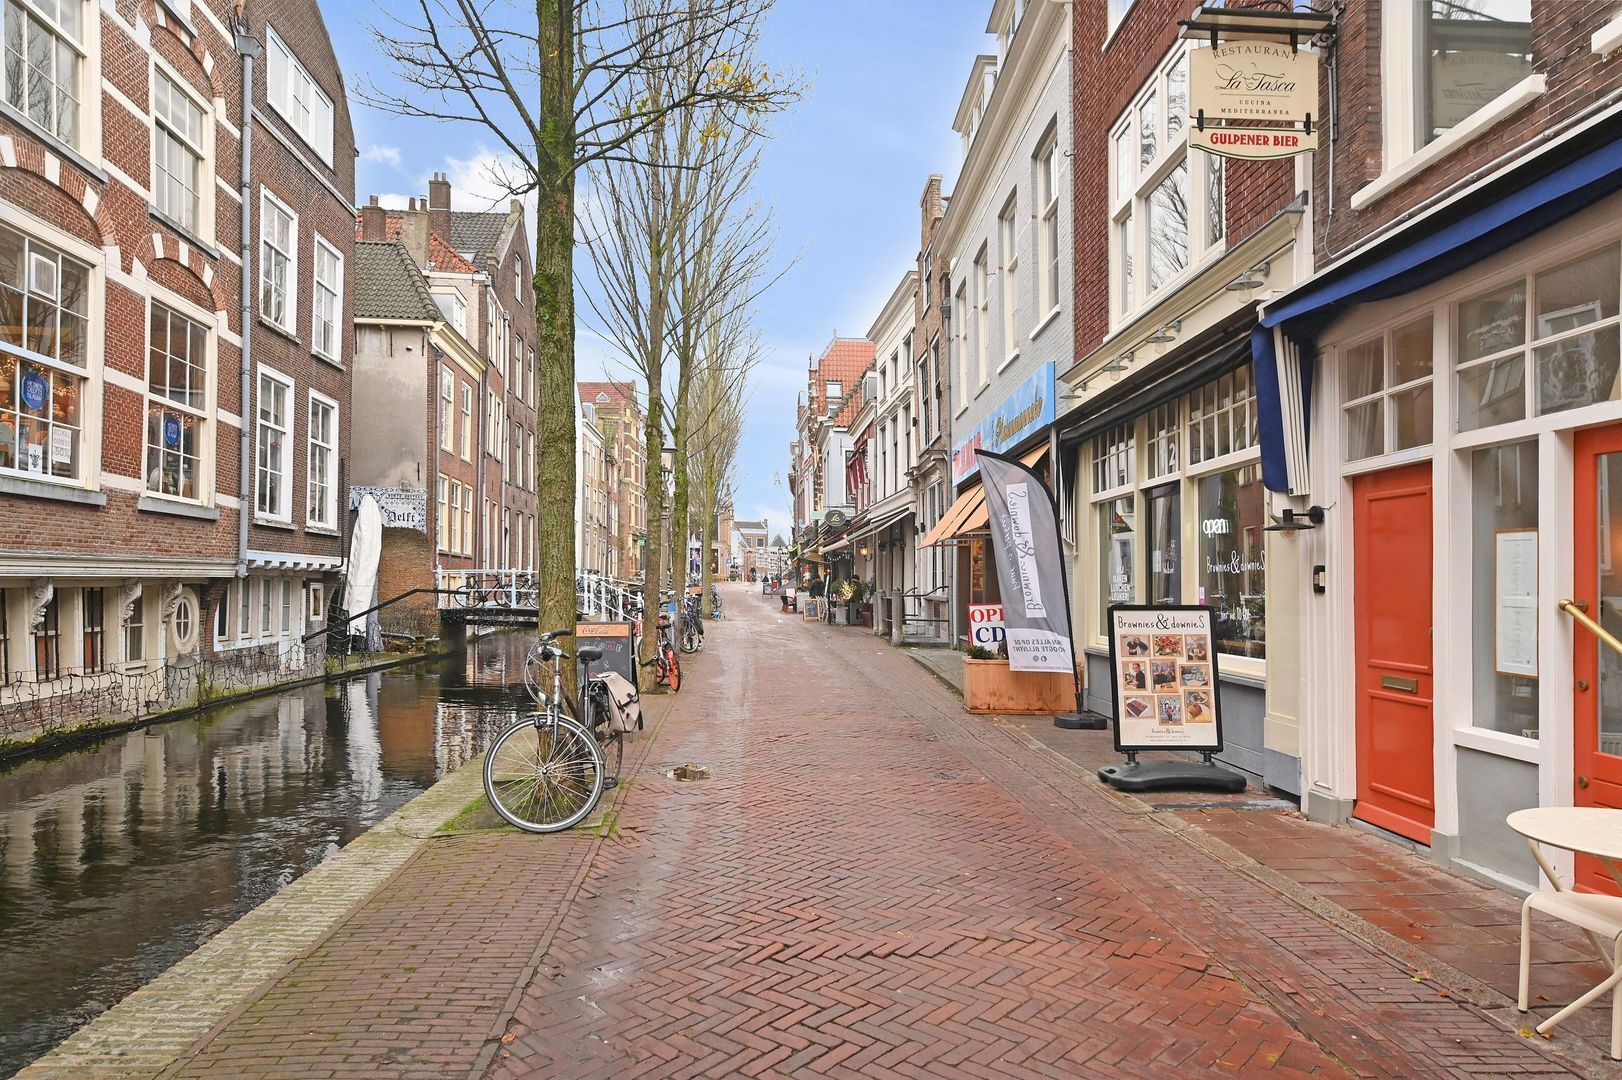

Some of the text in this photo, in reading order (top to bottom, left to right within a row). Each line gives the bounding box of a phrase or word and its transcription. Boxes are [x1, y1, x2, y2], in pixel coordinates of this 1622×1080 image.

[1212, 45, 1299, 63] RESTAURANT
[1214, 63, 1296, 92] La Tasca
[1220, 107, 1290, 116] MEDITERRANEA
[1210, 132, 1299, 147] GULPENER BIER
[384, 508, 416, 526] Delft
[1117, 615, 1155, 629] Brownies
[1156, 613, 1170, 630] &
